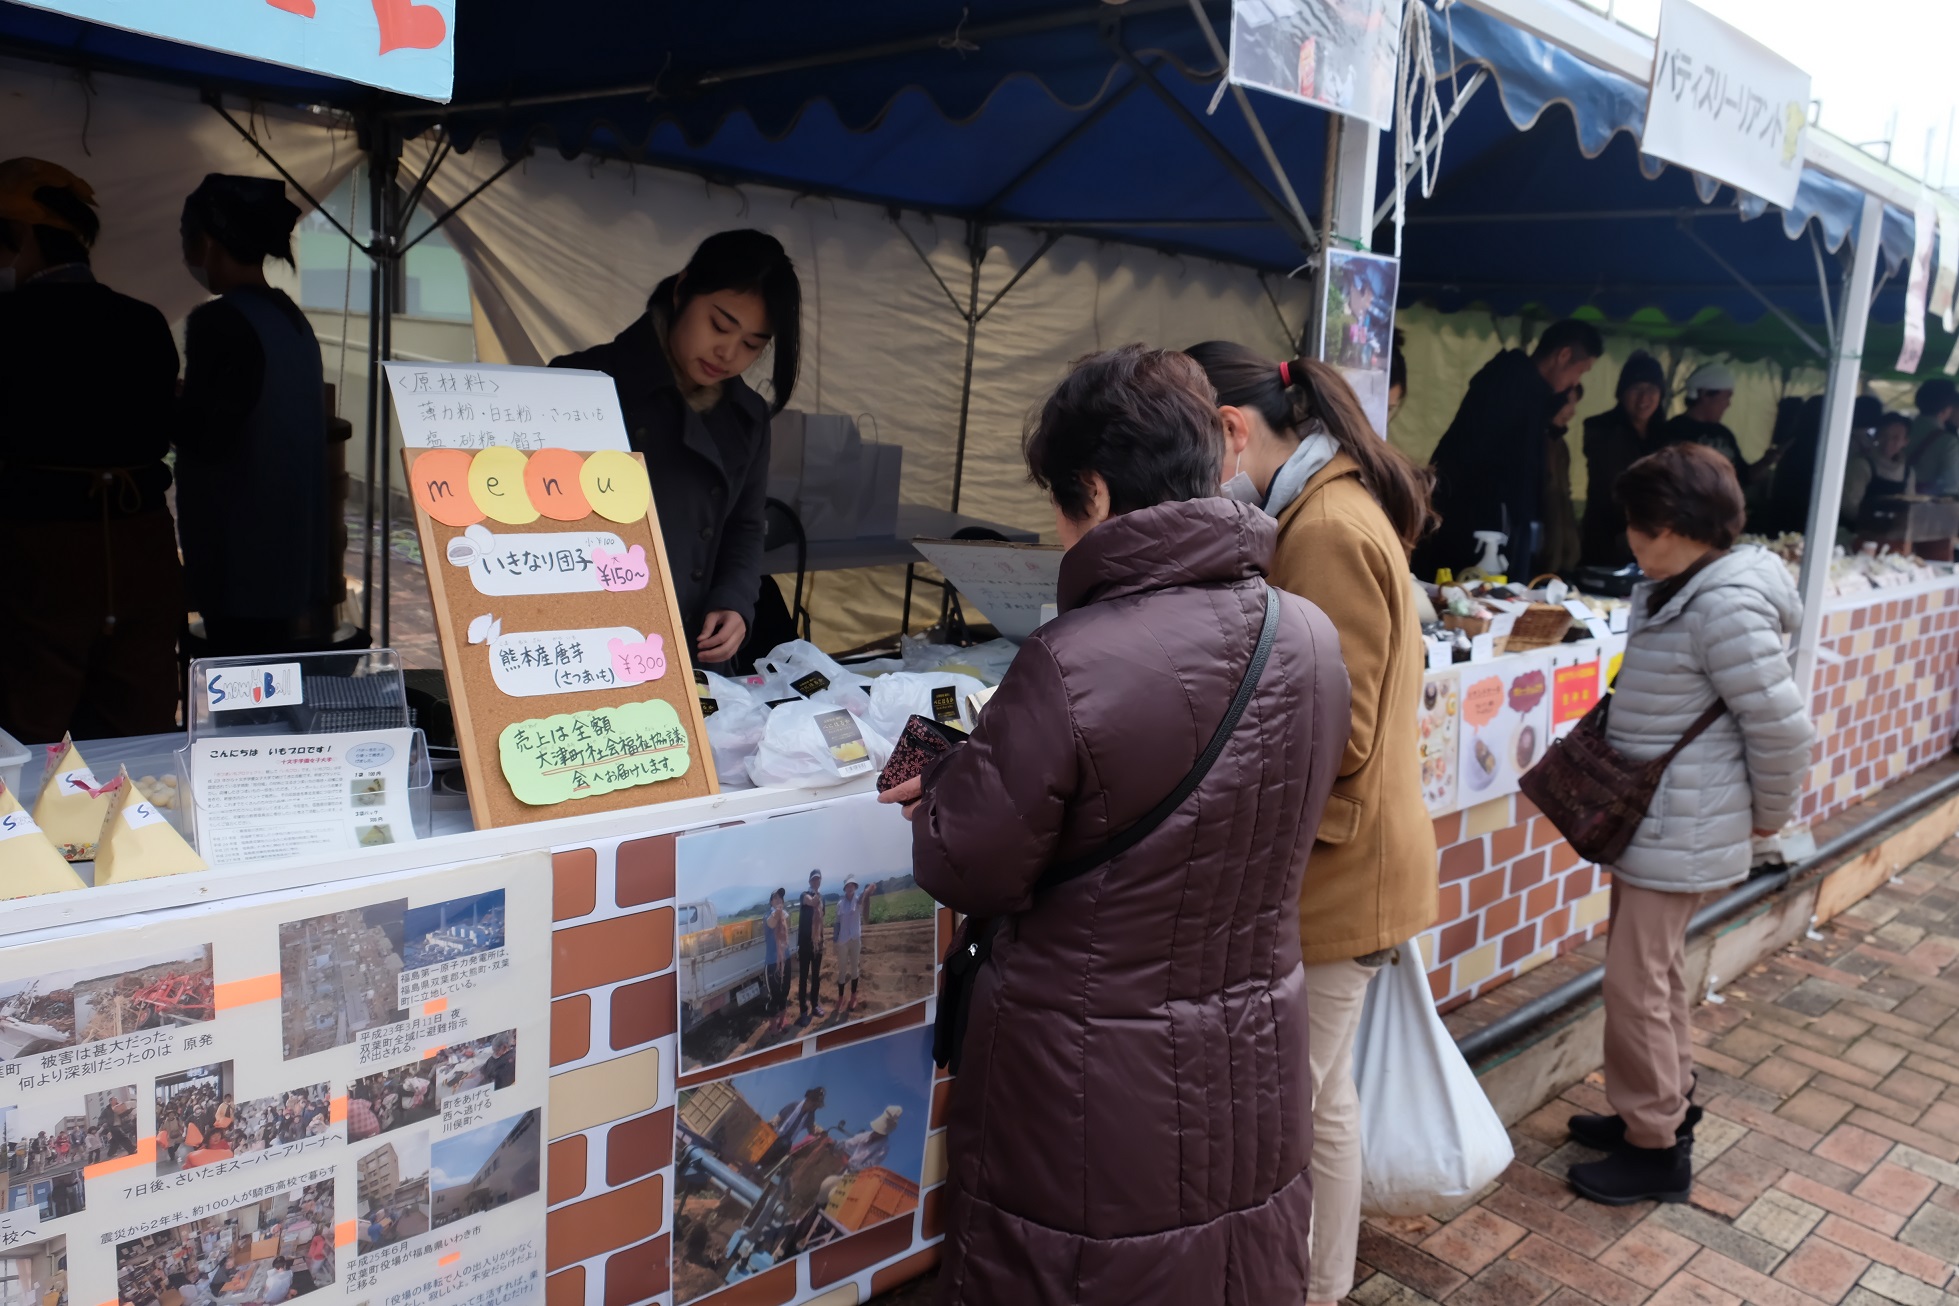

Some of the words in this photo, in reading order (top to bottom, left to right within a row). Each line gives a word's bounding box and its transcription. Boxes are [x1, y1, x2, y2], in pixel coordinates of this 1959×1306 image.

[482, 548, 593, 576] いきなり団子
[499, 641, 584, 673] 熊本産唐芋
[618, 653, 664, 675] ¥300
[513, 715, 616, 753] 売上は全額
[535, 727, 686, 769] 大津町社会福祉協議
[210, 749, 259, 759] こんにちは
[572, 756, 675, 788] 会へお届けします。
[400, 949, 509, 984] 福島第一原子力発電所は、
[400, 958, 510, 996] 福島県双葉郡大熊町・双葉
[400, 979, 477, 1007] 町に立地している。
[359, 1018, 468, 1055] 双葉町全域に避難指示
[360, 1013, 443, 1043] 平成23年3月11日
[450, 1008, 461, 1019] 夜
[0, 1062, 23, 1079] 町
[40, 1030, 174, 1070] 被害は甚大だった。
[19, 1043, 172, 1092] 何より深刻だったのは
[183, 1033, 213, 1051] 原発
[359, 1042, 416, 1065] が出される。
[442, 1088, 490, 1110] 町をあげて
[443, 1098, 492, 1122] 西へ逃げる
[346, 1225, 482, 1285] 双葉町役場が福島県いわき市
[346, 1240, 409, 1271] 平成25年6月
[346, 1276, 378, 1295] に移る
